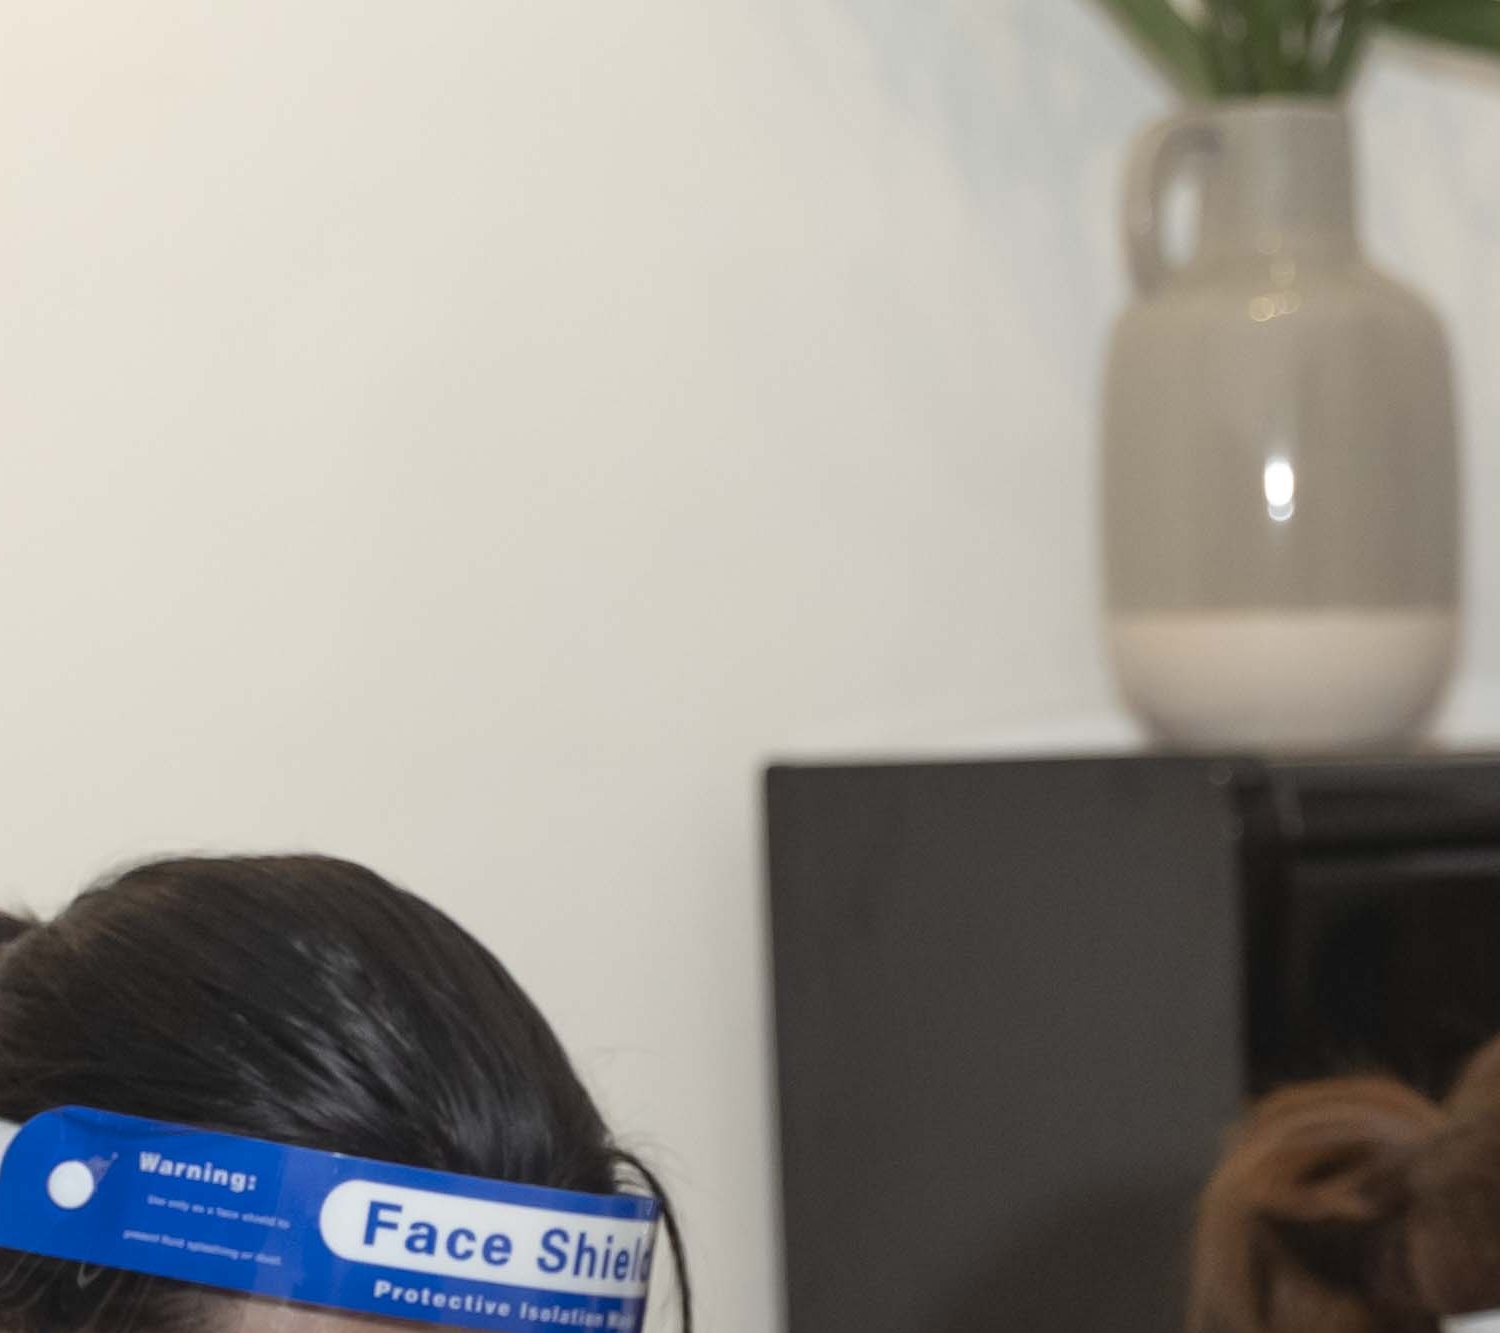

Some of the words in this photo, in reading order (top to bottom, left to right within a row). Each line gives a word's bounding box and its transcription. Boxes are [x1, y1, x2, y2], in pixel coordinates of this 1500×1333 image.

[140, 1151, 257, 1193] Warning:
[363, 1200, 513, 1266] Face
[373, 1279, 511, 1317] Protective
[520, 1302, 603, 1327] Isolation
